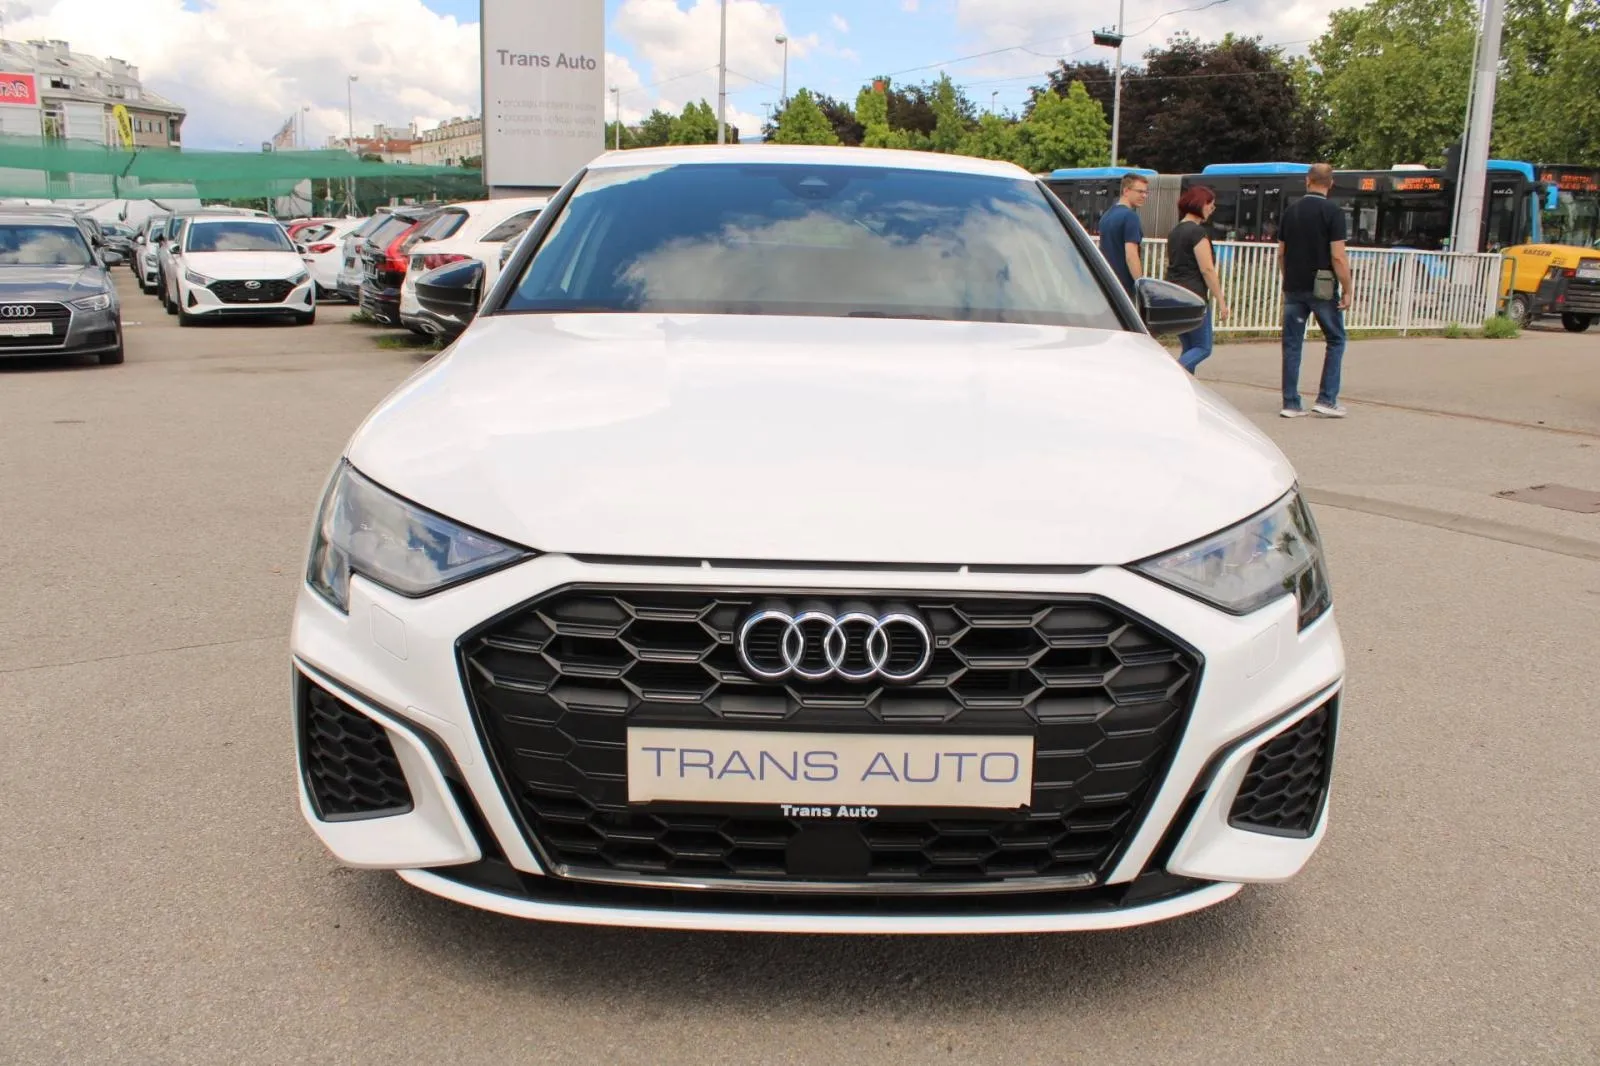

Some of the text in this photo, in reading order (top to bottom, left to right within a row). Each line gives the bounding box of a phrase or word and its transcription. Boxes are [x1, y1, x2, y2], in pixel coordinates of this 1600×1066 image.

[496, 49, 596, 70] Trans Auto
[641, 747, 1020, 783] TRANS AUTO
[780, 804, 879, 819] Trans Auto
